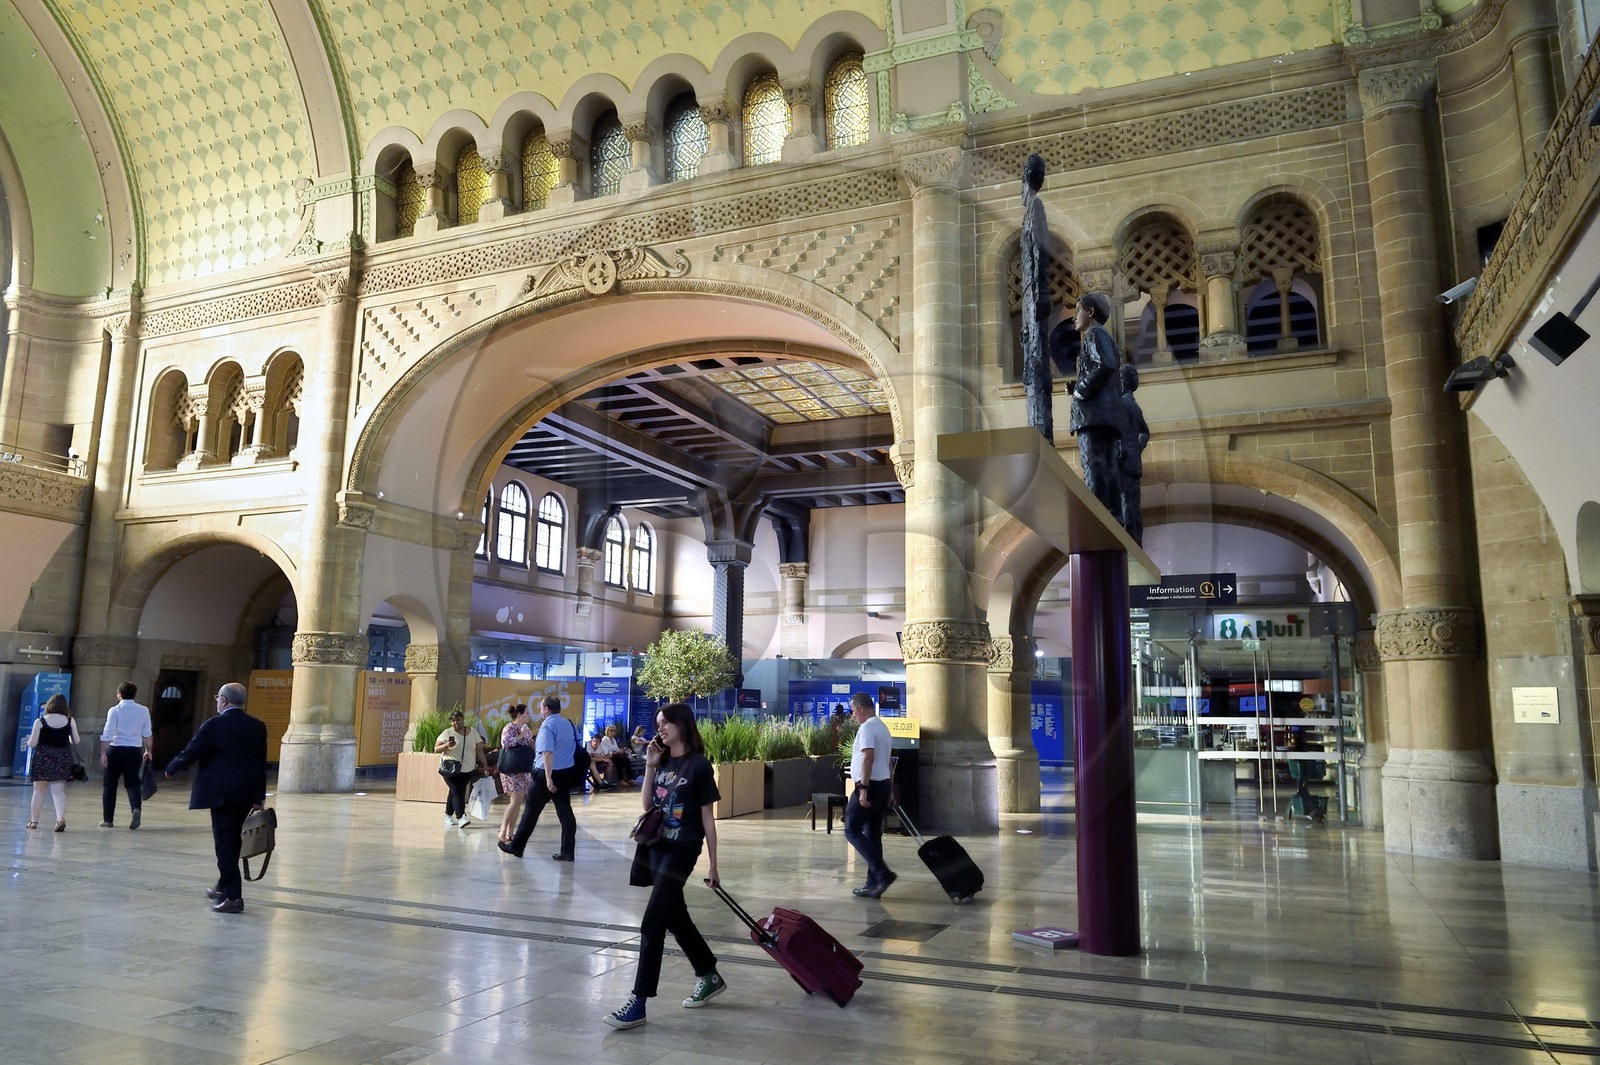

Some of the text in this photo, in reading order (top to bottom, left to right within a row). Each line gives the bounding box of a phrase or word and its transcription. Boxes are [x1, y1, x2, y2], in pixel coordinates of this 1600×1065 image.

[1149, 586, 1195, 594] Information
[1220, 618, 1237, 639] 8
[256, 678, 285, 686] FESTIVAL
[383, 710, 410, 719] THÉÂTR
[893, 722, 898, 730] DE
[899, 722, 912, 731] JOUER
